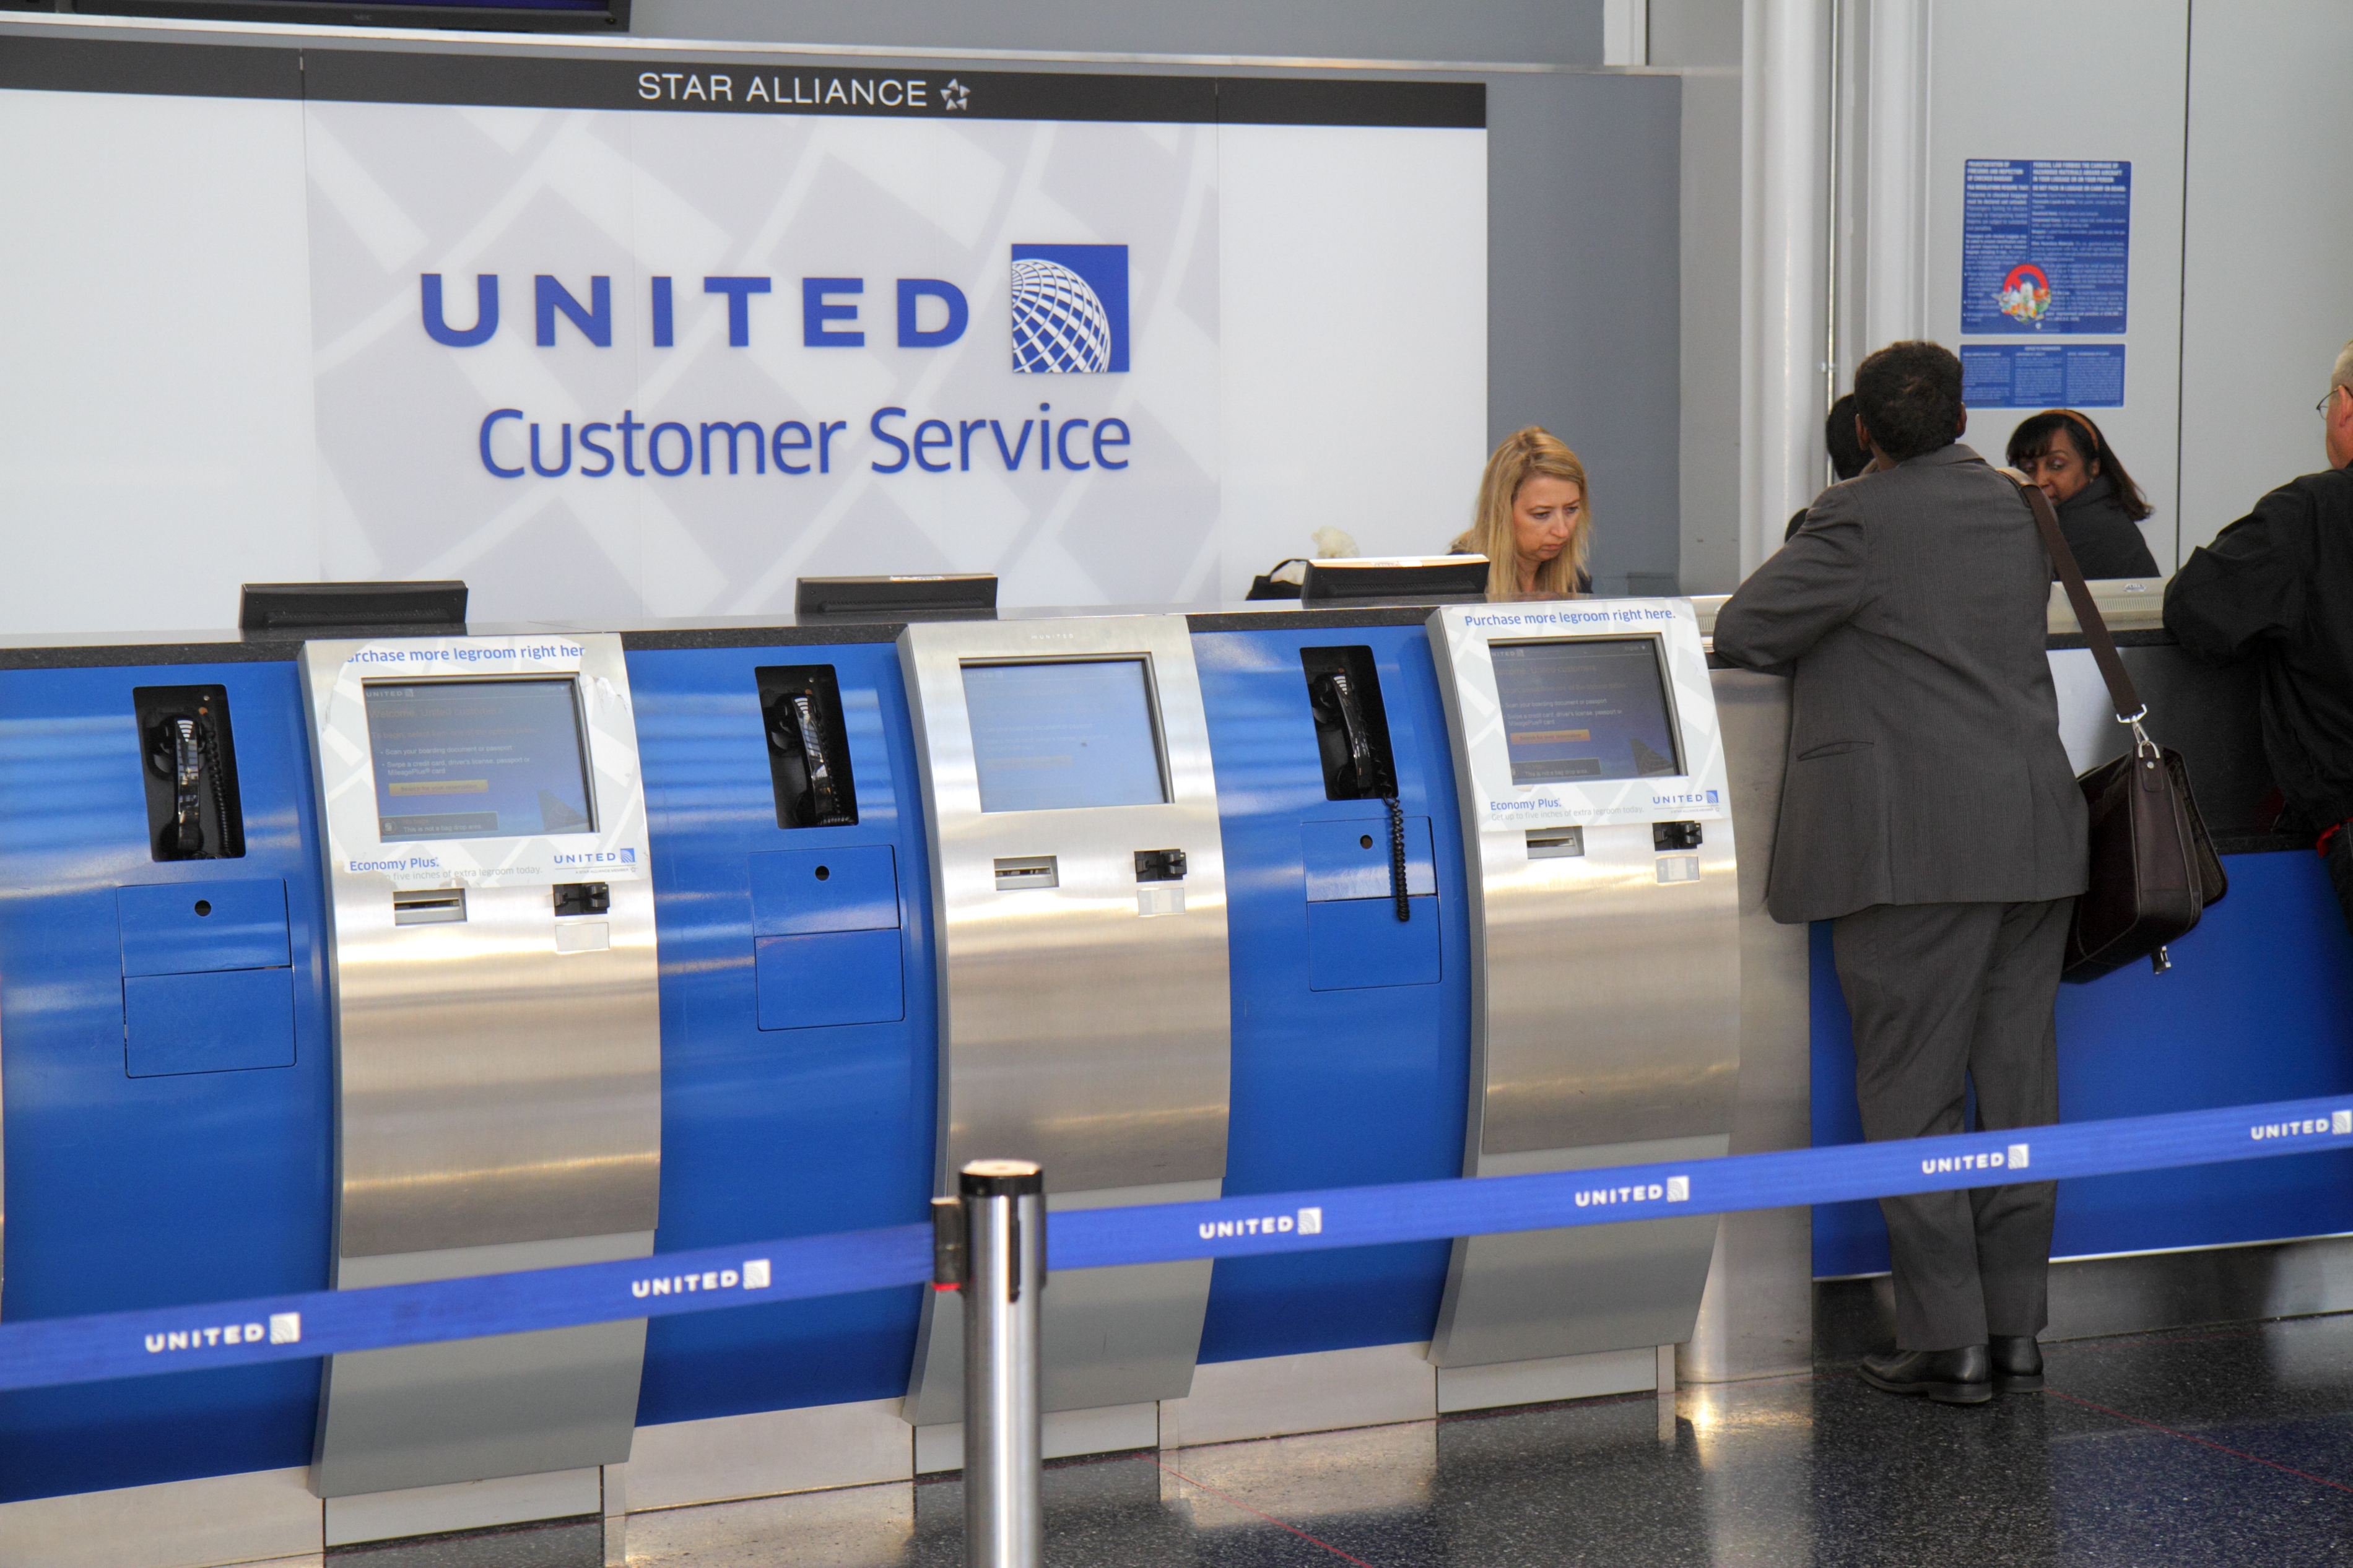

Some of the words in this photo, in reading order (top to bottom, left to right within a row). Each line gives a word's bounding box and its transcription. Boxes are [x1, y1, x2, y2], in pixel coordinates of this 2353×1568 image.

[638, 72, 732, 102] STAR
[746, 76, 927, 107] ALLIANCE
[420, 273, 971, 349] UNITED
[479, 406, 846, 479] Customer
[868, 402, 1131, 475] Service
[1465, 615, 1521, 626] Purchase
[1525, 614, 1557, 624] more
[1560, 612, 1609, 625] legroom
[1613, 609, 1642, 623] right
[1645, 609, 1676, 620] here.
[410, 649, 450, 661] more
[455, 648, 516, 662] legroom
[521, 645, 557, 660] right
[560, 644, 585, 657] her
[403, 748, 417, 756] your
[419, 747, 445, 756] boarding
[446, 745, 477, 753] document
[486, 745, 513, 753] passport
[387, 761, 406, 769] Swipe
[497, 756, 523, 765] passport
[1490, 800, 1535, 812] Economy
[1652, 794, 1703, 804] UNITED
[1492, 813, 1503, 821] Get
[1541, 810, 1563, 818] inches
[1593, 807, 1621, 816] legroom
[1624, 805, 1645, 814] today.
[440, 825, 452, 833] bag
[453, 824, 467, 832] drop
[350, 859, 406, 872] Economy
[554, 852, 615, 864] UNITED
[393, 872, 410, 881] five
[413, 870, 440, 880] inches
[443, 870, 451, 878] of
[454, 868, 476, 878] extra
[479, 867, 514, 878] legroom
[516, 865, 542, 876] today.
[2250, 1118, 2329, 1140] UNITED
[1921, 1151, 2005, 1175] UNITED
[1575, 1184, 1663, 1207] UNITED
[1199, 1215, 1294, 1240] UNITED
[632, 1270, 739, 1298] UNITED
[145, 1323, 265, 1354] UNITED
